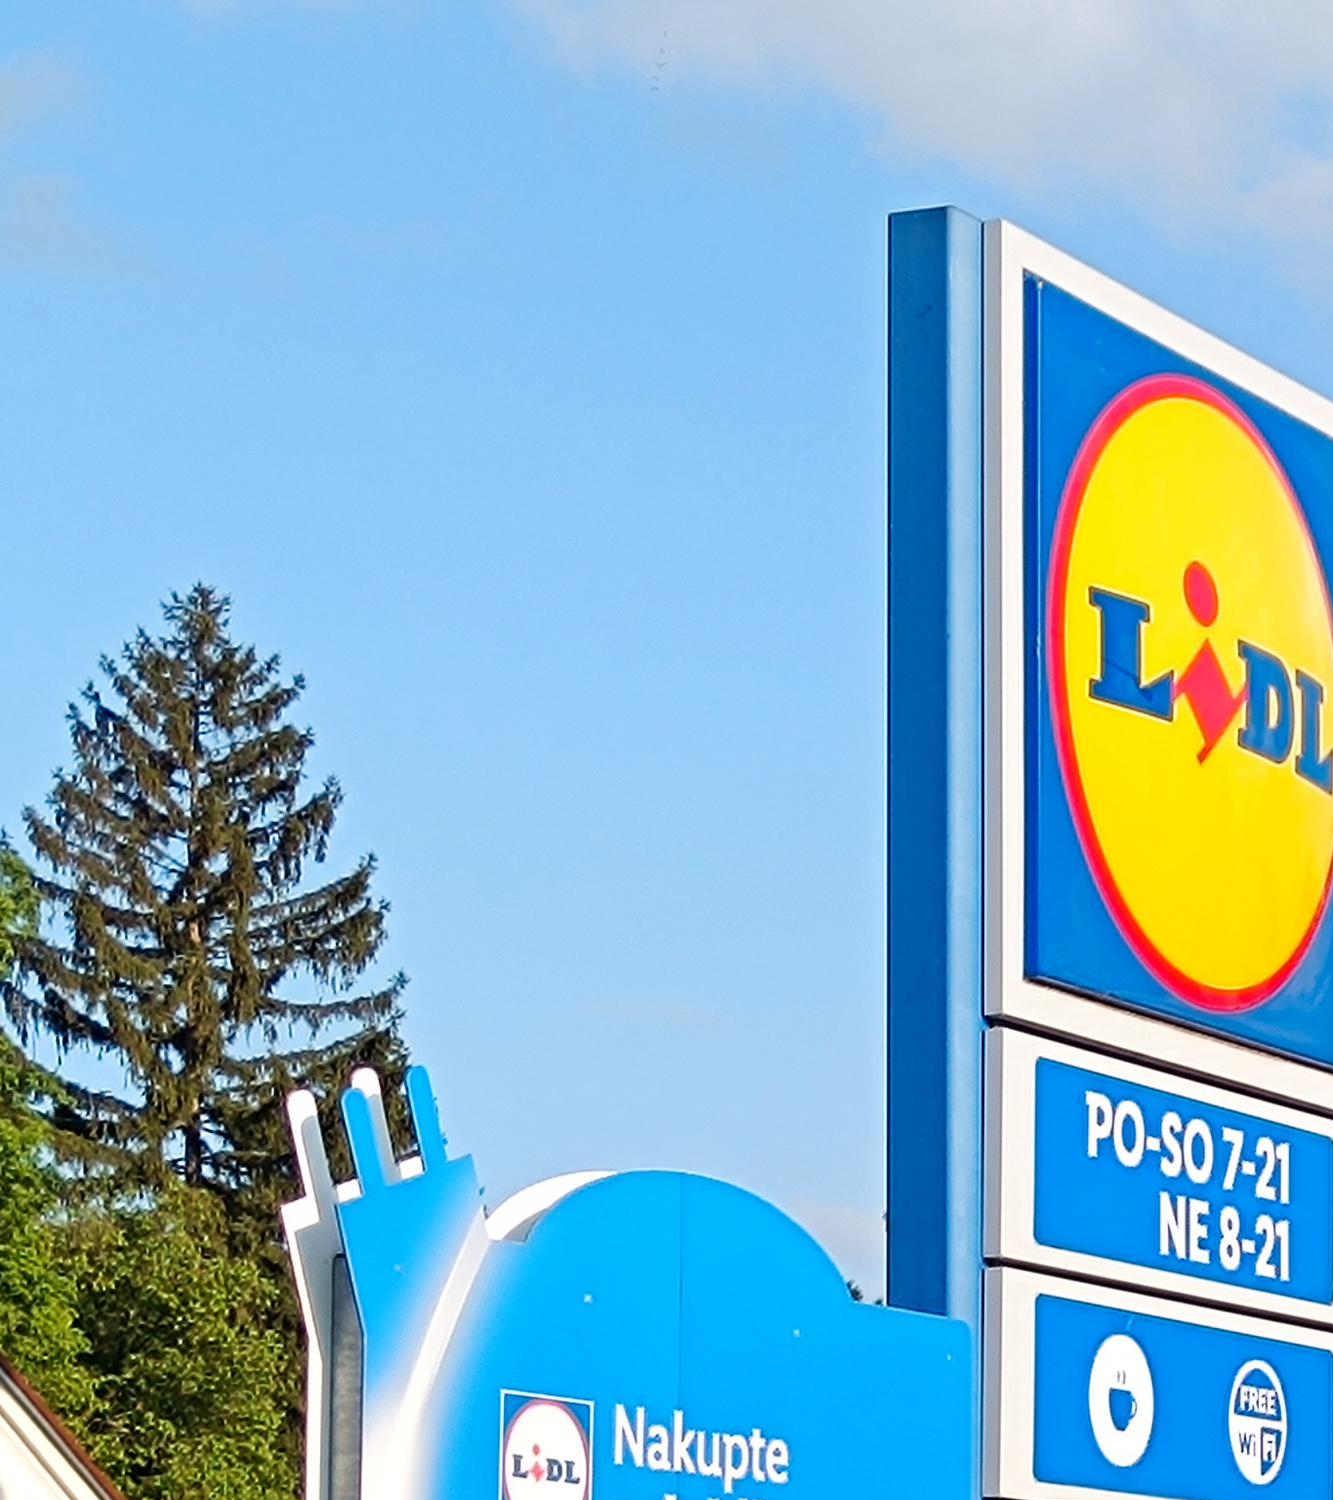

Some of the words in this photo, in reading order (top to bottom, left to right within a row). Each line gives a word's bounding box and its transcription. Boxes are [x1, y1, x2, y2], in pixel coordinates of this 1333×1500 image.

[1085, 1090, 1214, 1184] PO-SO
[1221, 1126, 1291, 1205] 7-21
[1159, 1191, 1211, 1265] NE
[1219, 1207, 1291, 1283] 8-21
[1239, 1384, 1278, 1416] FREE
[613, 1404, 789, 1494] Nakupte
